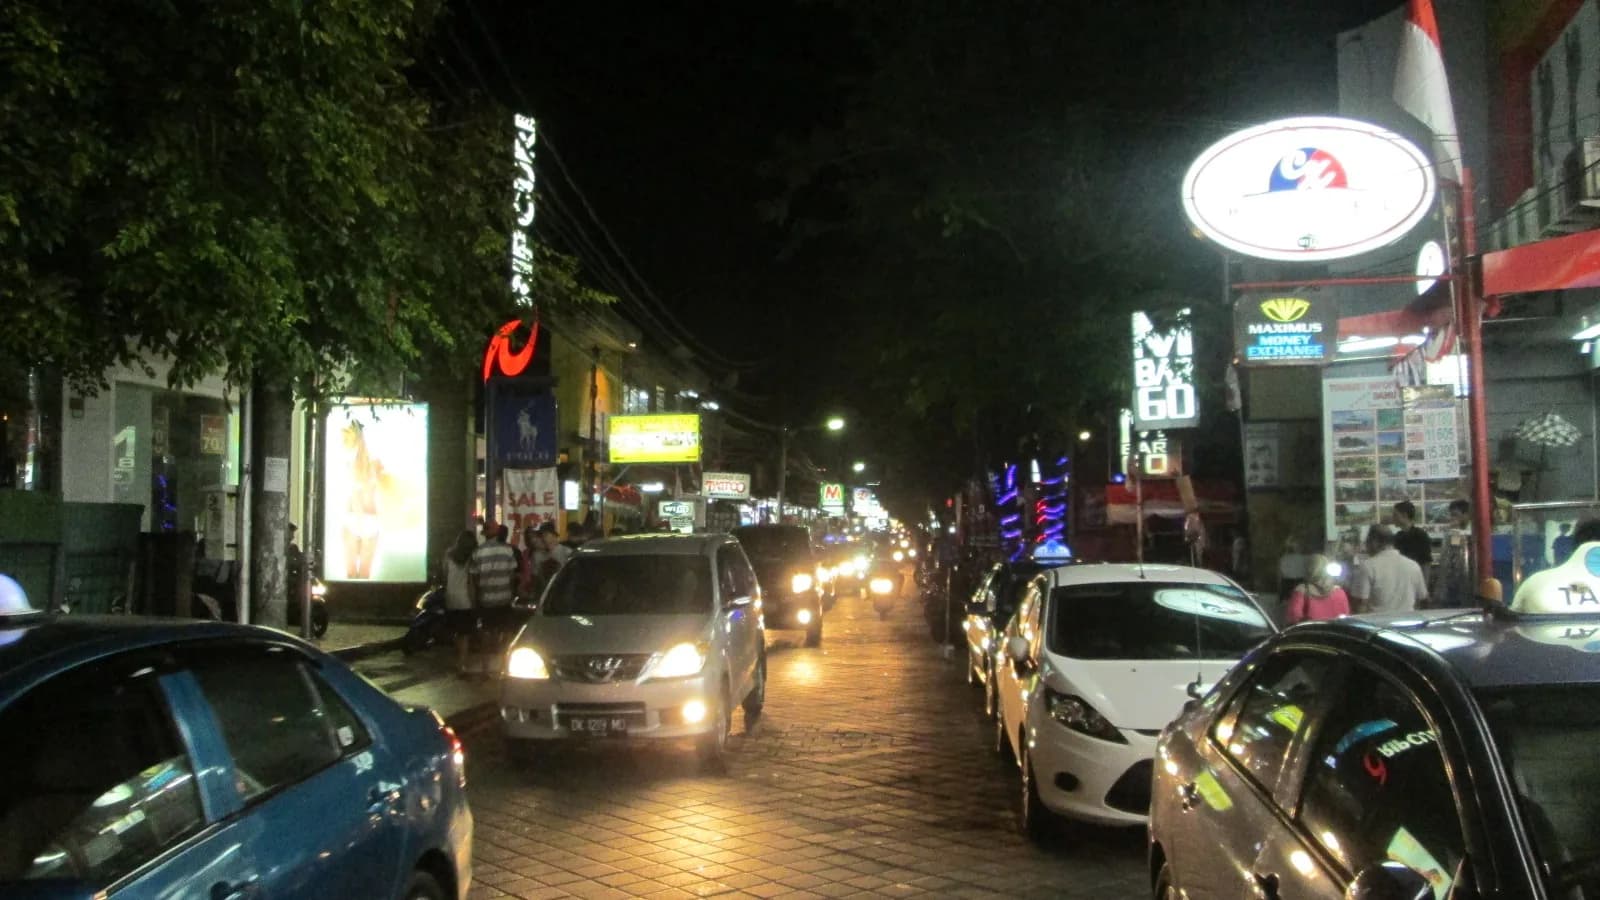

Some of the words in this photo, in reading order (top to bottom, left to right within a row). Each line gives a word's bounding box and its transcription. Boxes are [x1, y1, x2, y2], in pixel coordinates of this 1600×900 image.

[1248, 322, 1323, 334] MAXIMUS
[1258, 334, 1312, 345] MONEY
[1247, 345, 1323, 356] EXCHANGE
[508, 491, 555, 507] SALE
